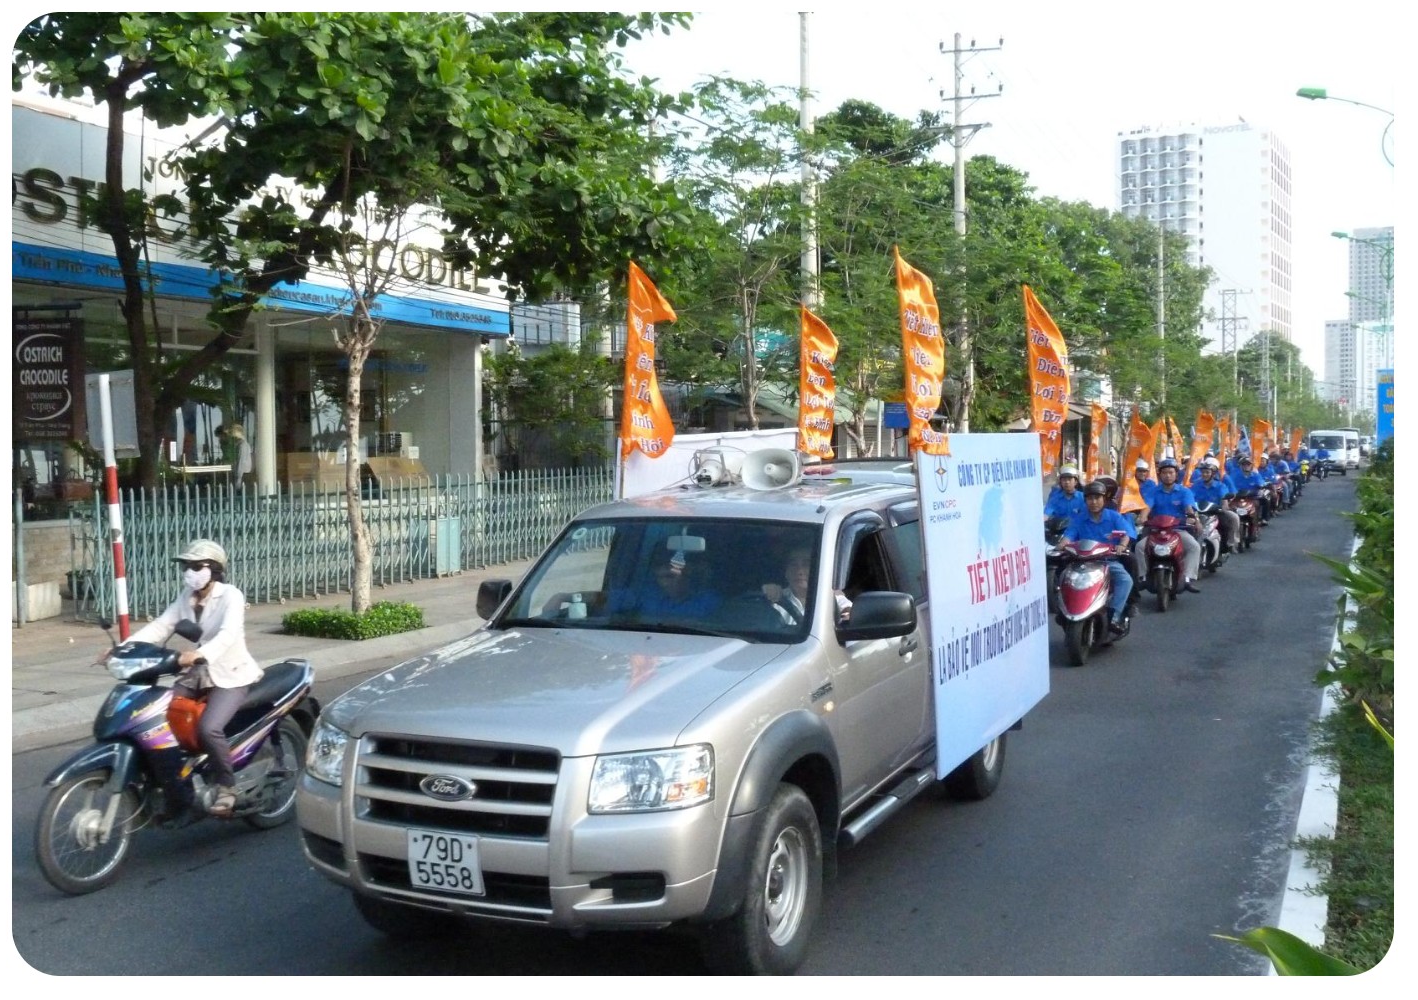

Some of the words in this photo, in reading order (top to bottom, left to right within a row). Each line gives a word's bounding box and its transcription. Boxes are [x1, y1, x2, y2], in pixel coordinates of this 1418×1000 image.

[24, 346, 63, 362] OSTRICH
[1037, 357, 1066, 379] Điện
[639, 438, 664, 454] Hội
[957, 459, 975, 488] CÔNG
[974, 462, 983, 486] TY
[983, 462, 991, 485] CP
[933, 499, 957, 511] EVNCPC
[967, 548, 991, 605] TIẾT
[992, 547, 1016, 602] KIỆM
[1015, 540, 1031, 592] ĐIỆN
[938, 635, 947, 686] LÀ
[948, 626, 960, 680] BẢO
[960, 627, 969, 680] VỆ
[970, 622, 982, 669] MÔI
